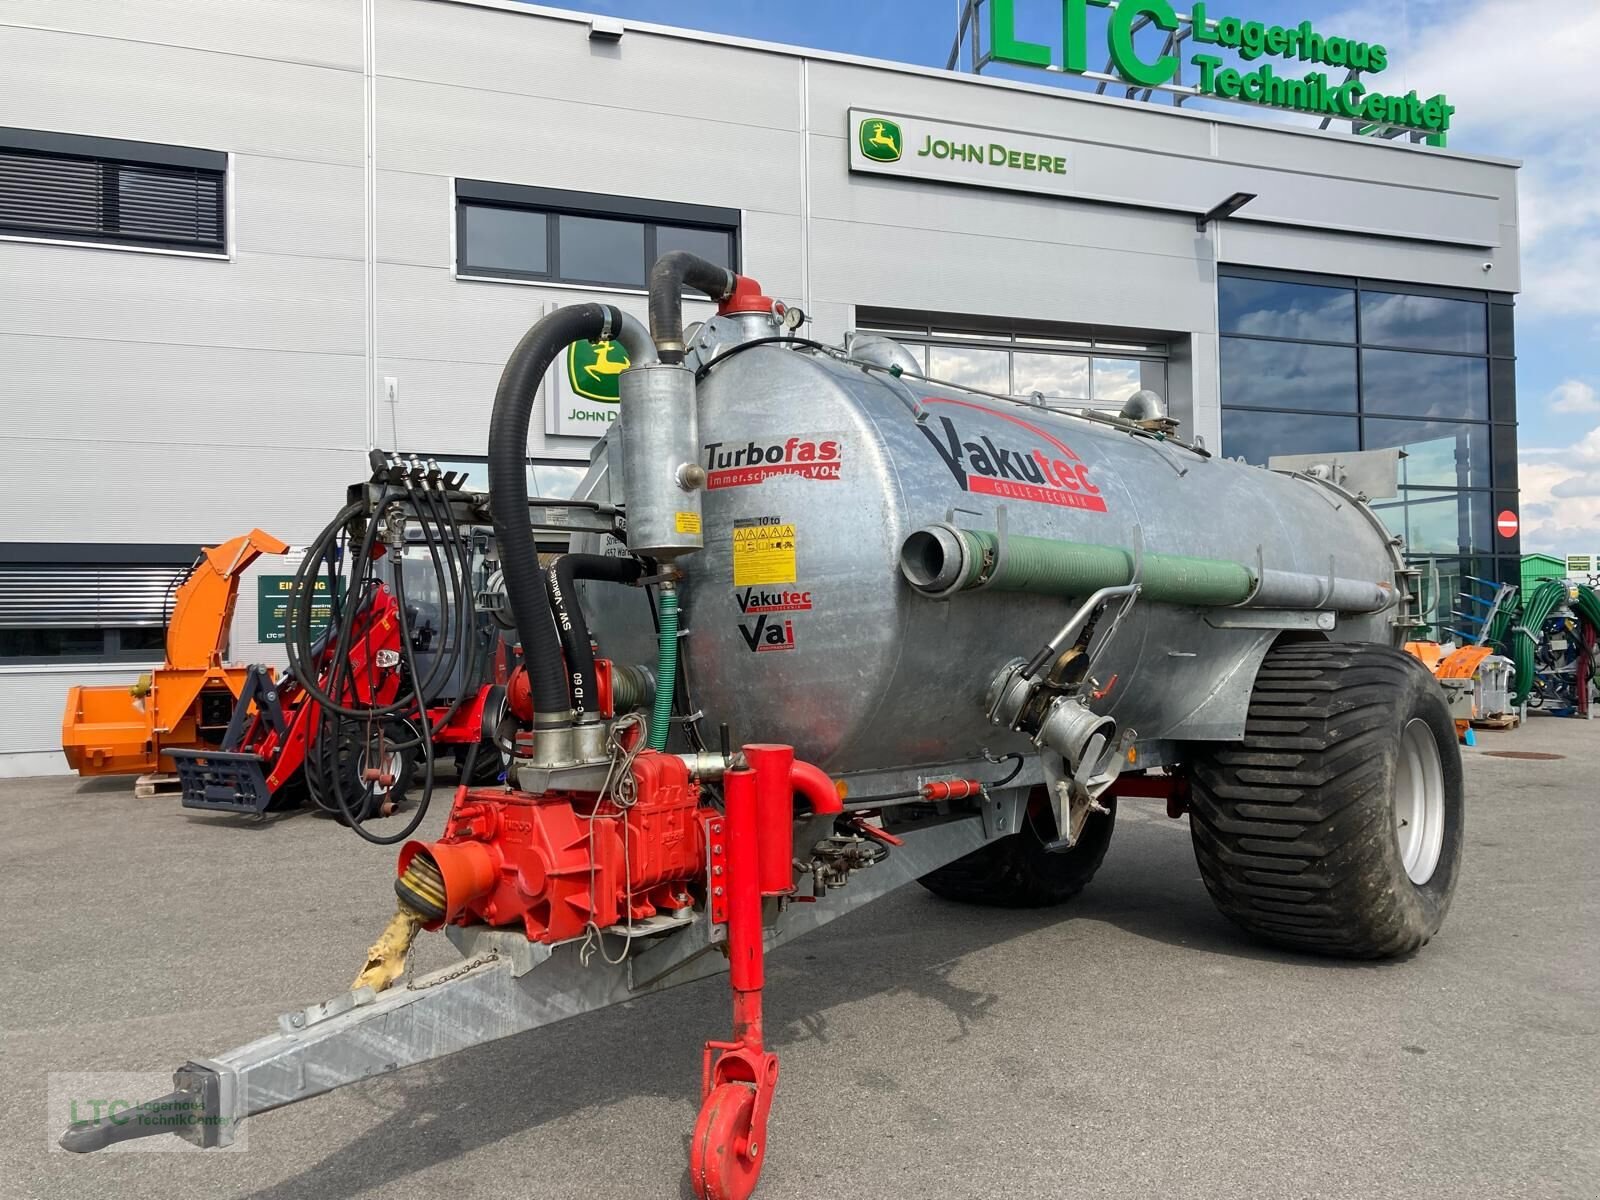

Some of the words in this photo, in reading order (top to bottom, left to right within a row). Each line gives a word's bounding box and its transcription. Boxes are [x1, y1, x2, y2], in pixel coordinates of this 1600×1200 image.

[1192, 2, 1388, 73] Lagerhaus
[1191, 53, 1455, 132] TechnikCenter
[917, 135, 983, 164] JOHN
[989, 143, 1067, 175] DEERE
[568, 408, 605, 421] JOHN
[704, 437, 842, 471] Turbofas
[916, 416, 1100, 494] Vakutec
[758, 516, 769, 526] 10
[735, 587, 812, 613] Vakutec
[559, 612, 572, 631] SW
[738, 614, 795, 652] Vai
[573, 672, 583, 685] 60
[574, 687, 584, 698] ID
